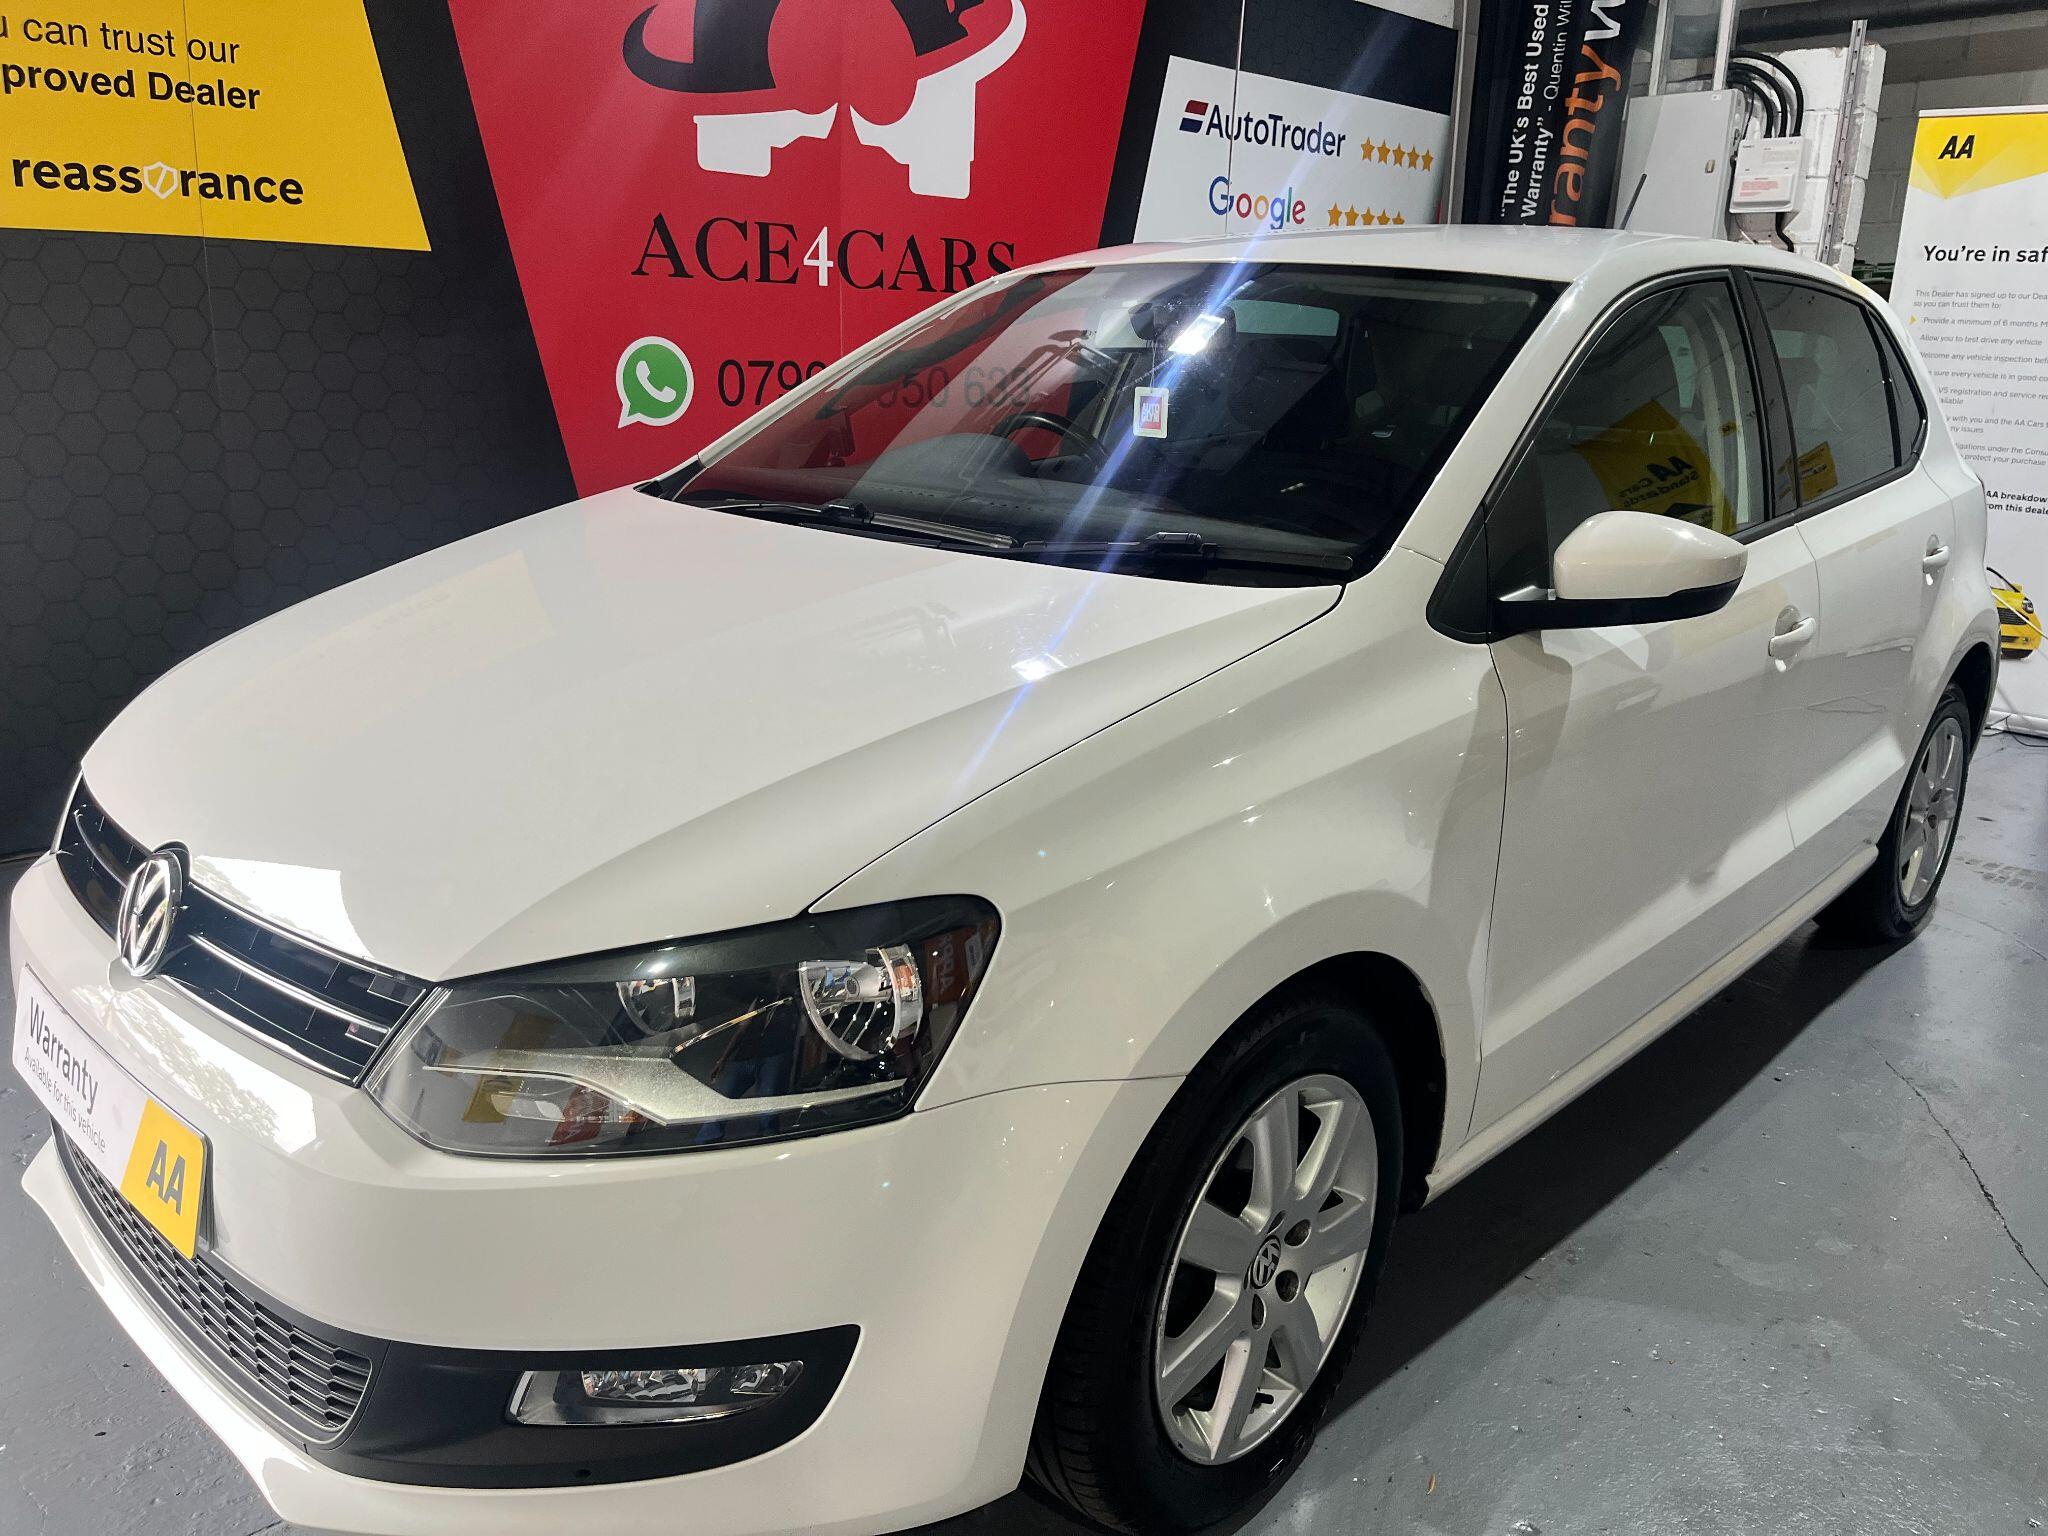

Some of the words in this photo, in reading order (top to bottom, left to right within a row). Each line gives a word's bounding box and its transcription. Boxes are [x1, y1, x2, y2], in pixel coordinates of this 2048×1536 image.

[23, 18, 88, 48] can
[100, 22, 176, 57] trust
[187, 37, 240, 64] our
[1526, 4, 1549, 57] Used
[1517, 63, 1539, 110] Best
[1543, 32, 1567, 100] Quentin
[148, 71, 261, 110] Dealer
[1205, 104, 1346, 157] AutoTrader
[1938, 134, 1975, 160] AA
[1209, 176, 1306, 229] Google
[631, 212, 1015, 295] ACE4CARS
[1992, 245, 2010, 262] in
[1923, 301, 1936, 309] you
[1931, 290, 1954, 298] Dealer
[1955, 290, 1969, 298] has
[1970, 291, 1995, 300] signed
[1923, 316, 1949, 325] Provide
[2015, 338, 2042, 346] vehicle
[1950, 387, 1992, 398] registration
[2010, 457, 2047, 466] purchase
[2005, 503, 2023, 513] this
[29, 996, 98, 1115] Warranty
[24, 1046, 52, 1094] Available
[52, 1080, 63, 1104] for
[63, 1093, 77, 1122] this
[77, 1112, 106, 1154] vehicle
[146, 1139, 186, 1217] AA
